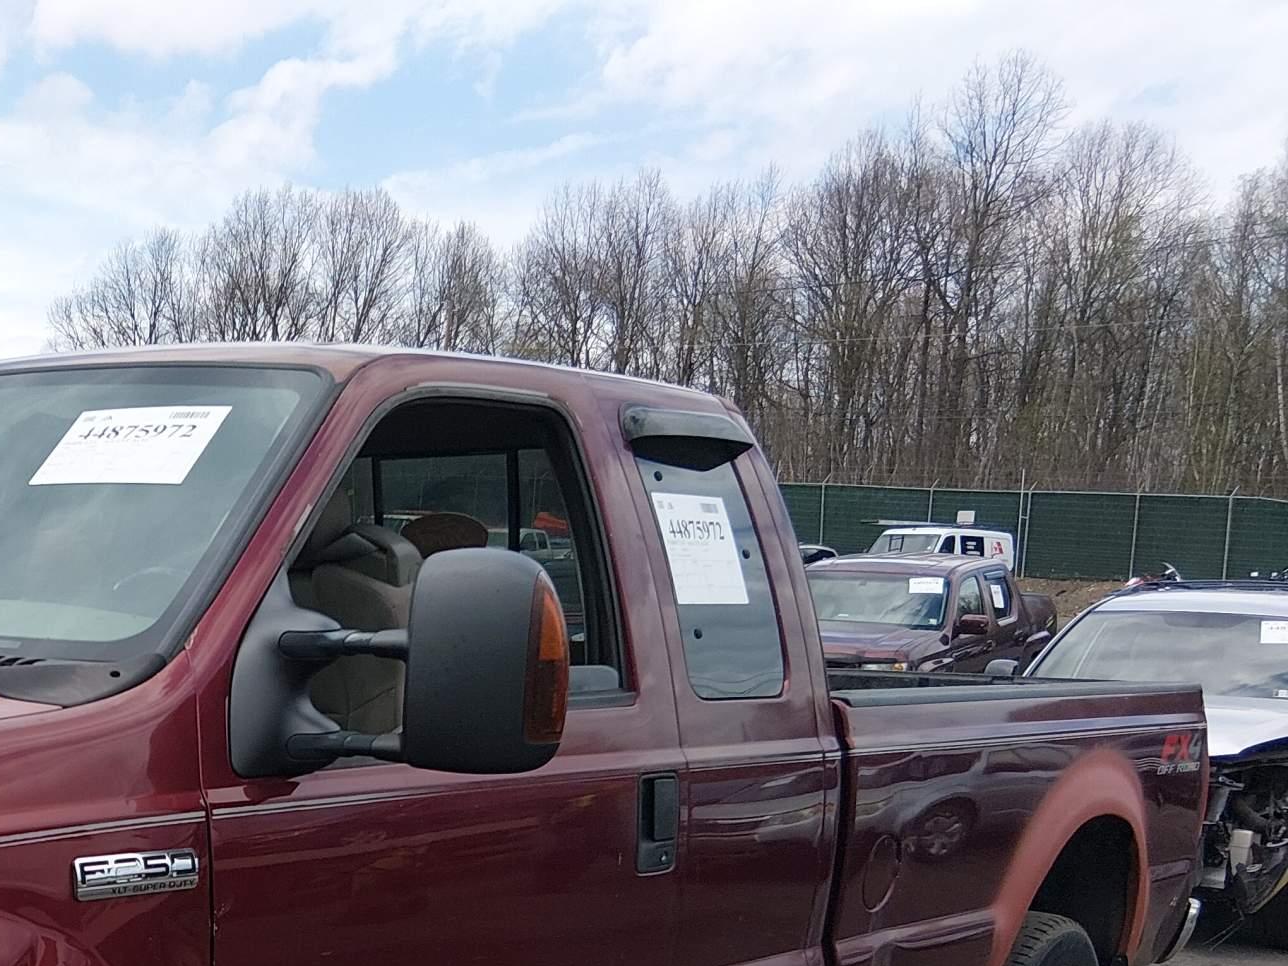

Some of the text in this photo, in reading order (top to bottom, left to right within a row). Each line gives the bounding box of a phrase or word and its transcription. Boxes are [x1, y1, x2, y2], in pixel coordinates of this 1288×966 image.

[78, 424, 198, 440] 44875972
[668, 519, 725, 540] 44875972
[1159, 733, 1202, 764] FX4
[1156, 761, 1201, 776] OFF ROAD
